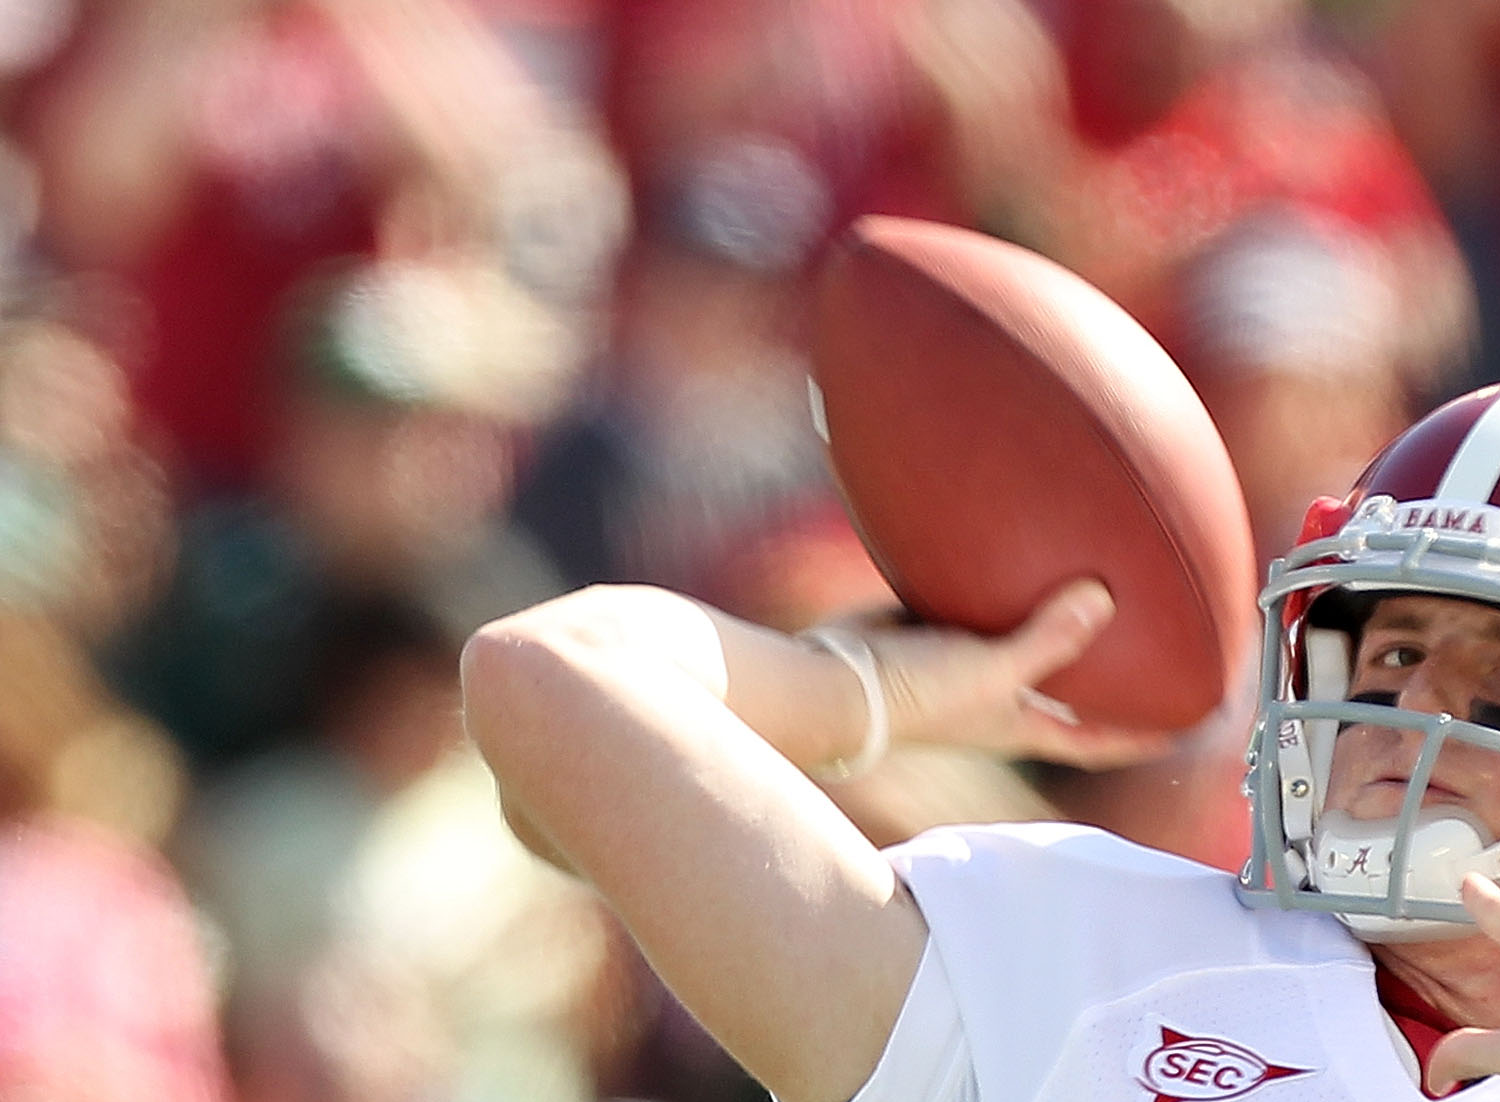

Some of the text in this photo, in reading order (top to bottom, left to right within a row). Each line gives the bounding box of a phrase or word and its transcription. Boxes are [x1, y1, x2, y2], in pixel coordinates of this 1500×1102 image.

[1405, 507, 1486, 534] BAMA
[1345, 847, 1371, 874] A
[1160, 1053, 1243, 1090] SEC
